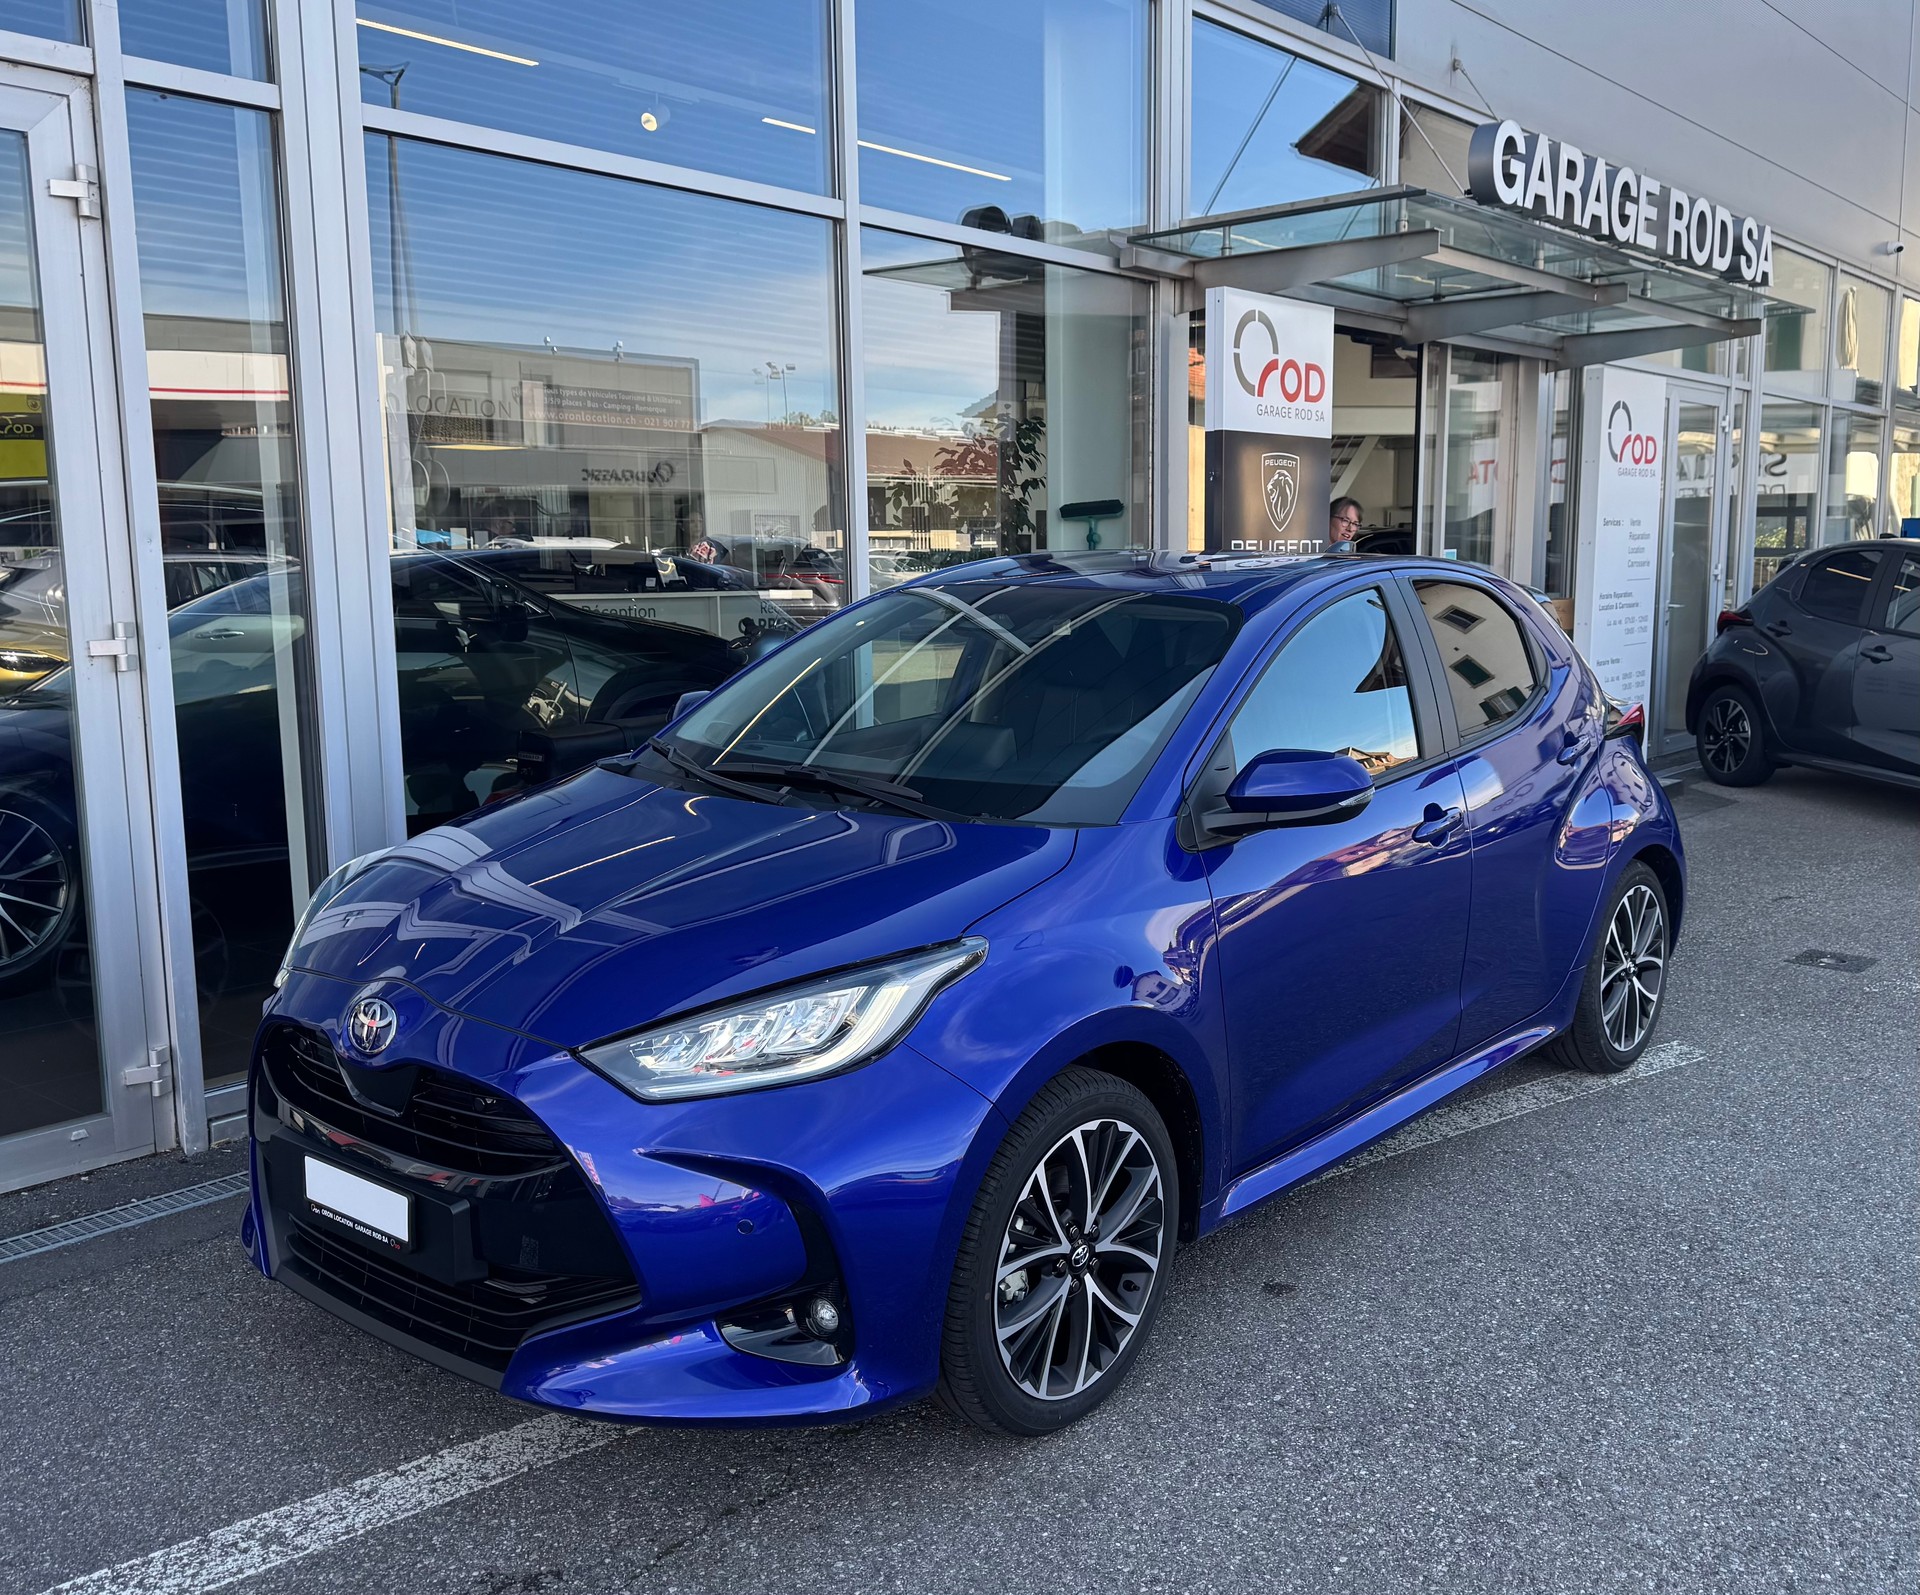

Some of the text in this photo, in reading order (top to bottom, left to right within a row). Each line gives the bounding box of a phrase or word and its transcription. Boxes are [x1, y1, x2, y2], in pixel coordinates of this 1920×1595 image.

[1493, 119, 1775, 287] GARAGE ROD SA
[560, 387, 577, 397] types
[579, 389, 587, 397] de
[618, 392, 646, 402] Tourisme
[562, 398, 582, 408] places
[587, 400, 599, 409] Bus
[603, 401, 631, 412] Camping
[635, 404, 667, 414] Remorque
[1256, 403, 1325, 422] GARAGE ROD SA
[644, 417, 660, 426] 021
[663, 418, 678, 428] 907
[1265, 459, 1297, 468] PEUGEOT
[1618, 467, 1638, 477] GARAGE
[1639, 468, 1649, 478] ROD
[321, 1208, 333, 1220] ORON
[333, 1213, 353, 1229] LOCATION
[354, 1223, 372, 1237] GARAGE
[372, 1230, 382, 1241] ROD
